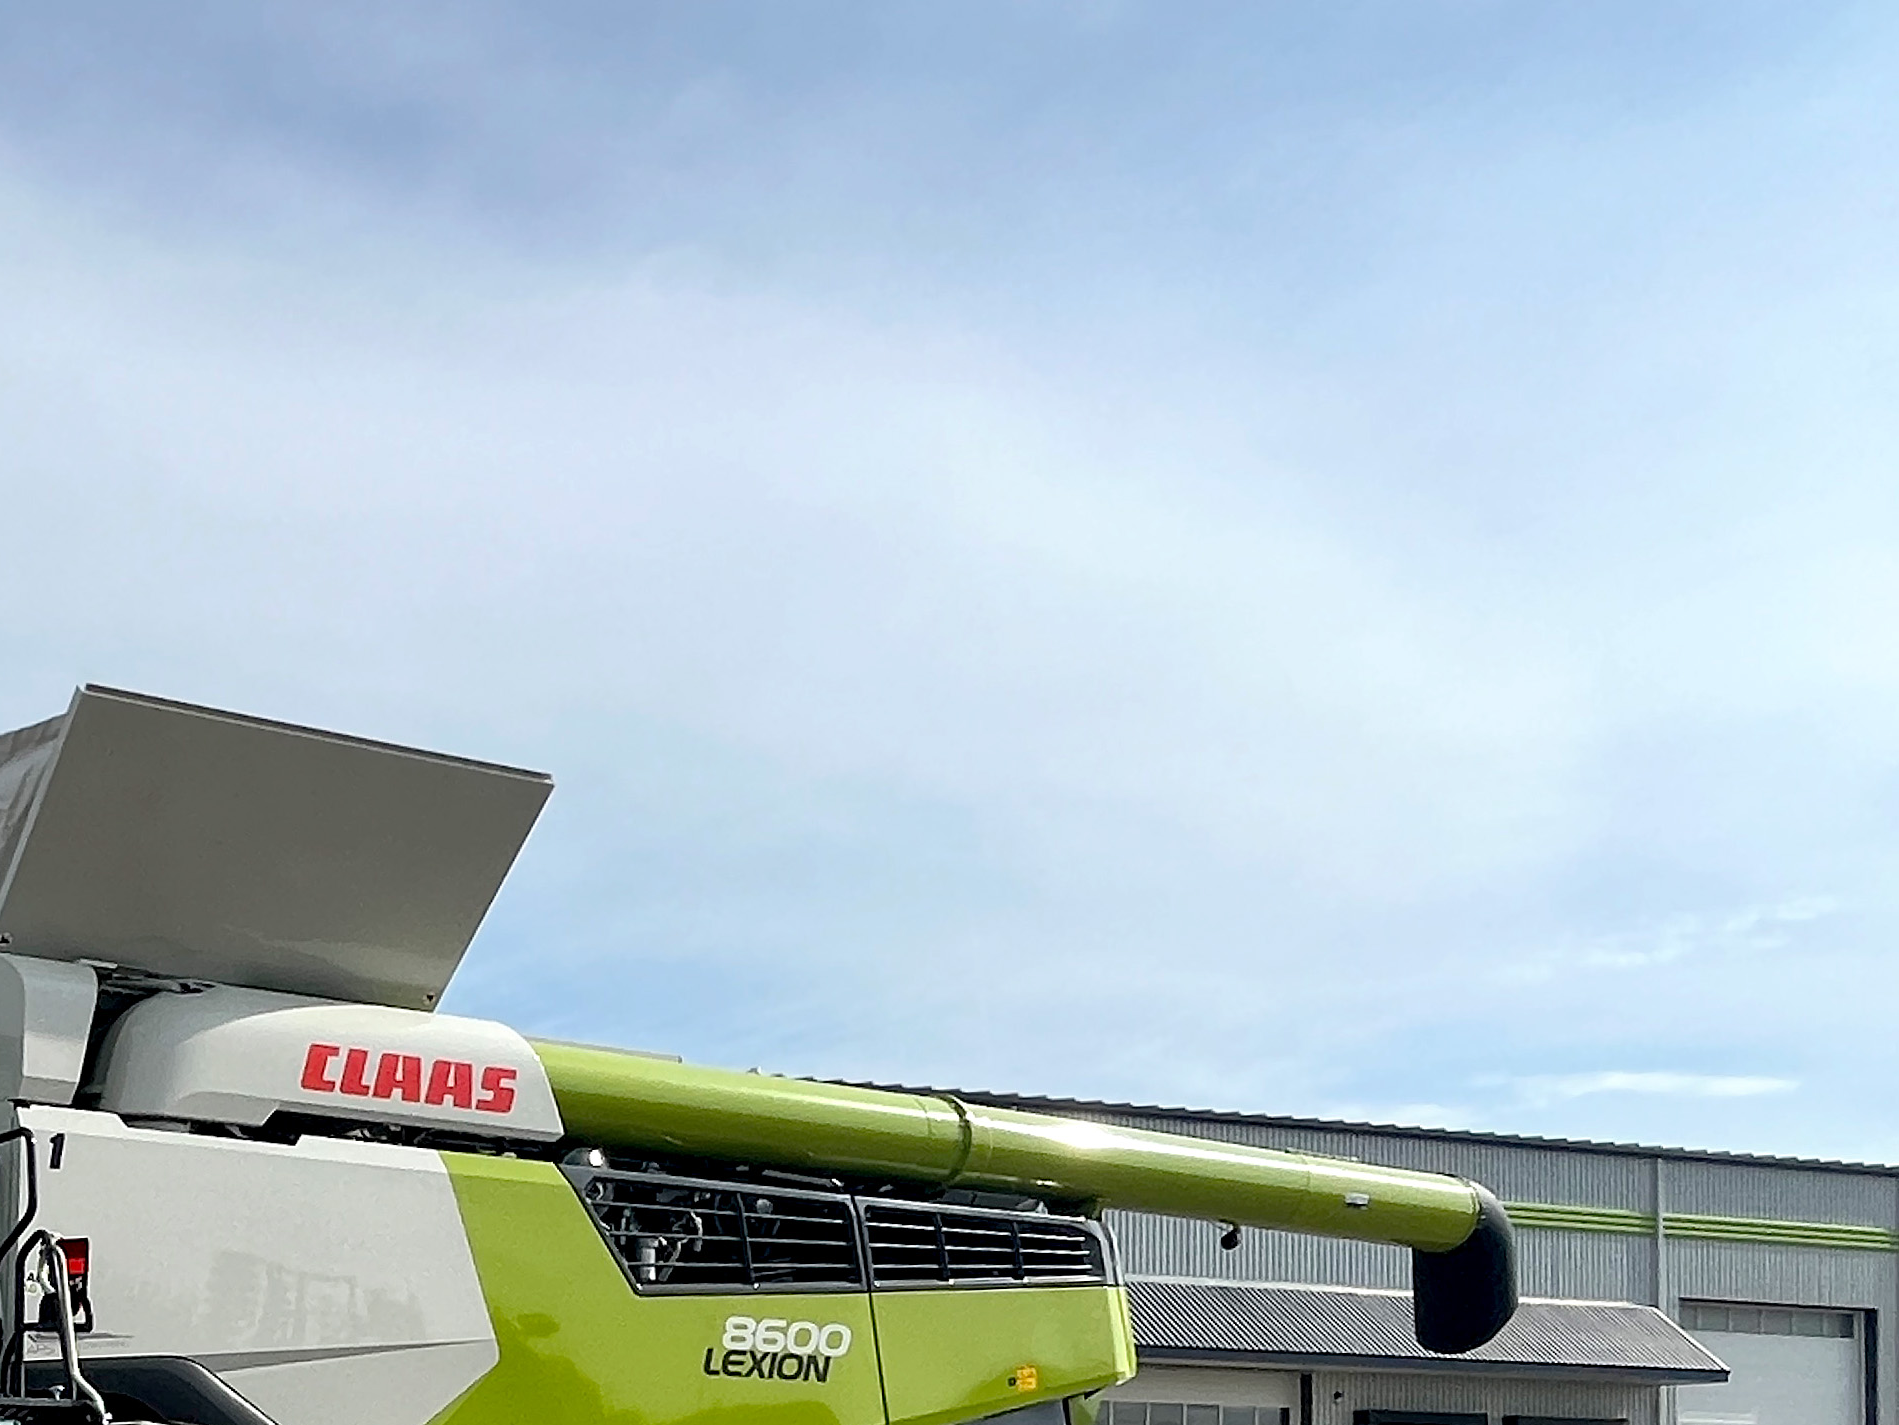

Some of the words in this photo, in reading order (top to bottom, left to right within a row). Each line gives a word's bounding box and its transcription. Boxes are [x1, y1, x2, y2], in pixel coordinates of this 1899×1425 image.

[301, 1043, 517, 1114] CLAAS
[50, 1133, 66, 1169] 1
[722, 1316, 852, 1357] 8600
[704, 1348, 832, 1382] LEXION
